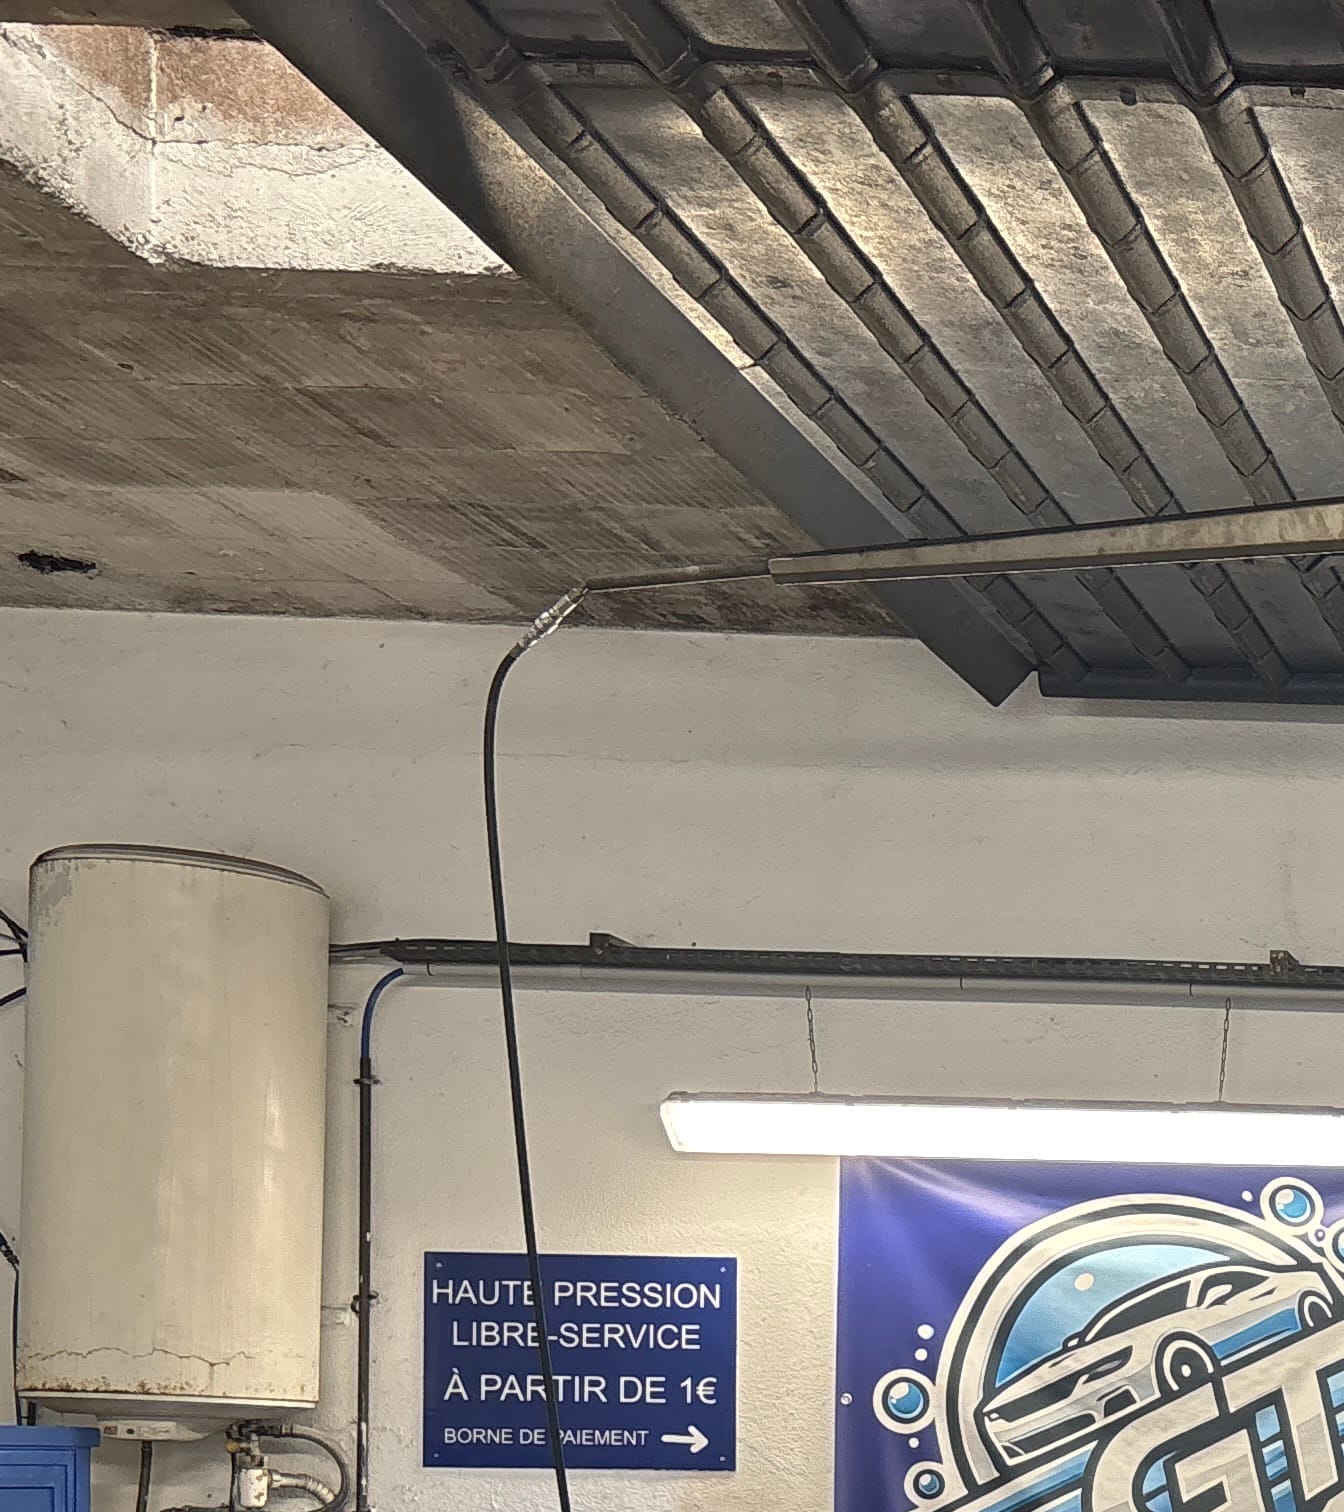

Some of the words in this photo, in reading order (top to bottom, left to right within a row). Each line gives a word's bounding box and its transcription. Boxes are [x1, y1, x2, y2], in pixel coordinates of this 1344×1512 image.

[432, 1279, 537, 1305] HAUTE
[554, 1281, 721, 1309] PRESSION
[452, 1321, 701, 1350] LIBRE-SERVICE
[443, 1367, 469, 1401] À
[480, 1374, 608, 1403] PARTIR
[619, 1376, 667, 1404] DE
[680, 1377, 718, 1405] 1€
[444, 1427, 514, 1445] BORNE
[519, 1428, 546, 1445] DE
